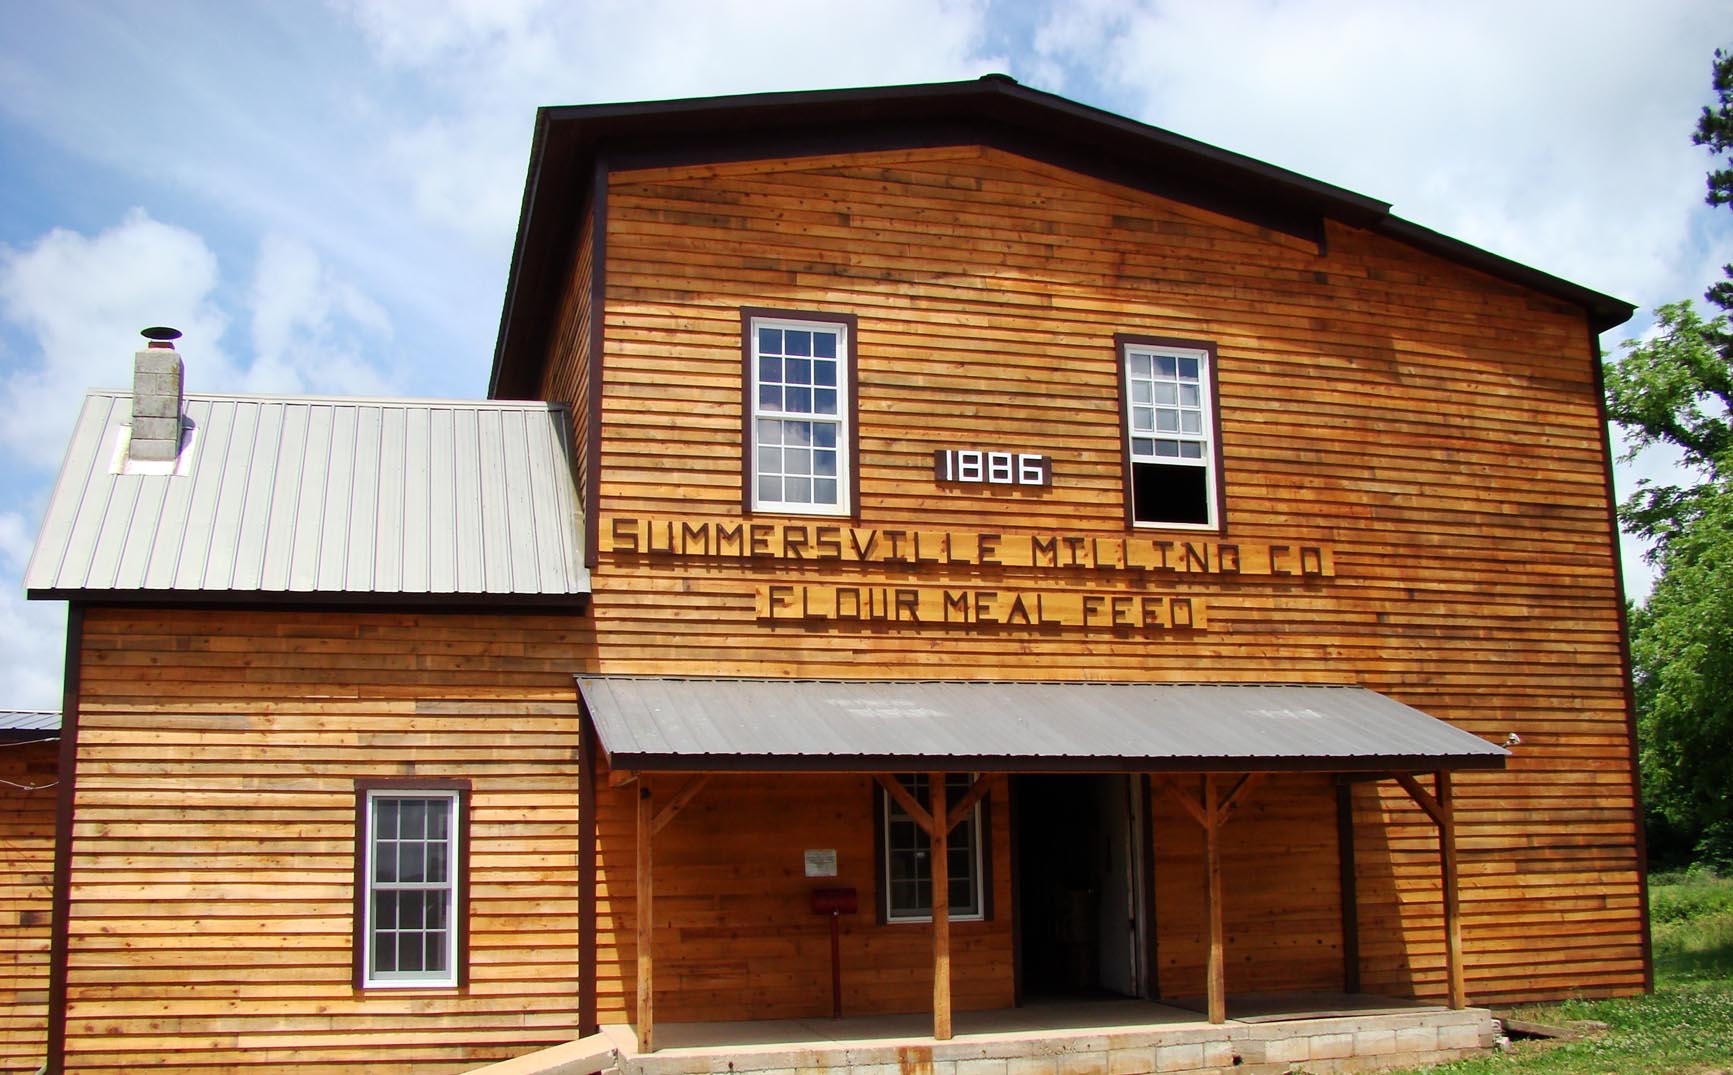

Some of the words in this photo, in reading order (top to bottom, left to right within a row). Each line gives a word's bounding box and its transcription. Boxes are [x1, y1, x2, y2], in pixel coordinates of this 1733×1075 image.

[946, 449, 1044, 485] 1886
[612, 518, 1002, 565] SUMMERSVILLE
[1031, 536, 1241, 575] MILLING
[1269, 545, 1323, 577] CO
[769, 585, 920, 622] FLOUR
[943, 590, 1062, 627] MEAL
[1083, 596, 1194, 630] FEED
